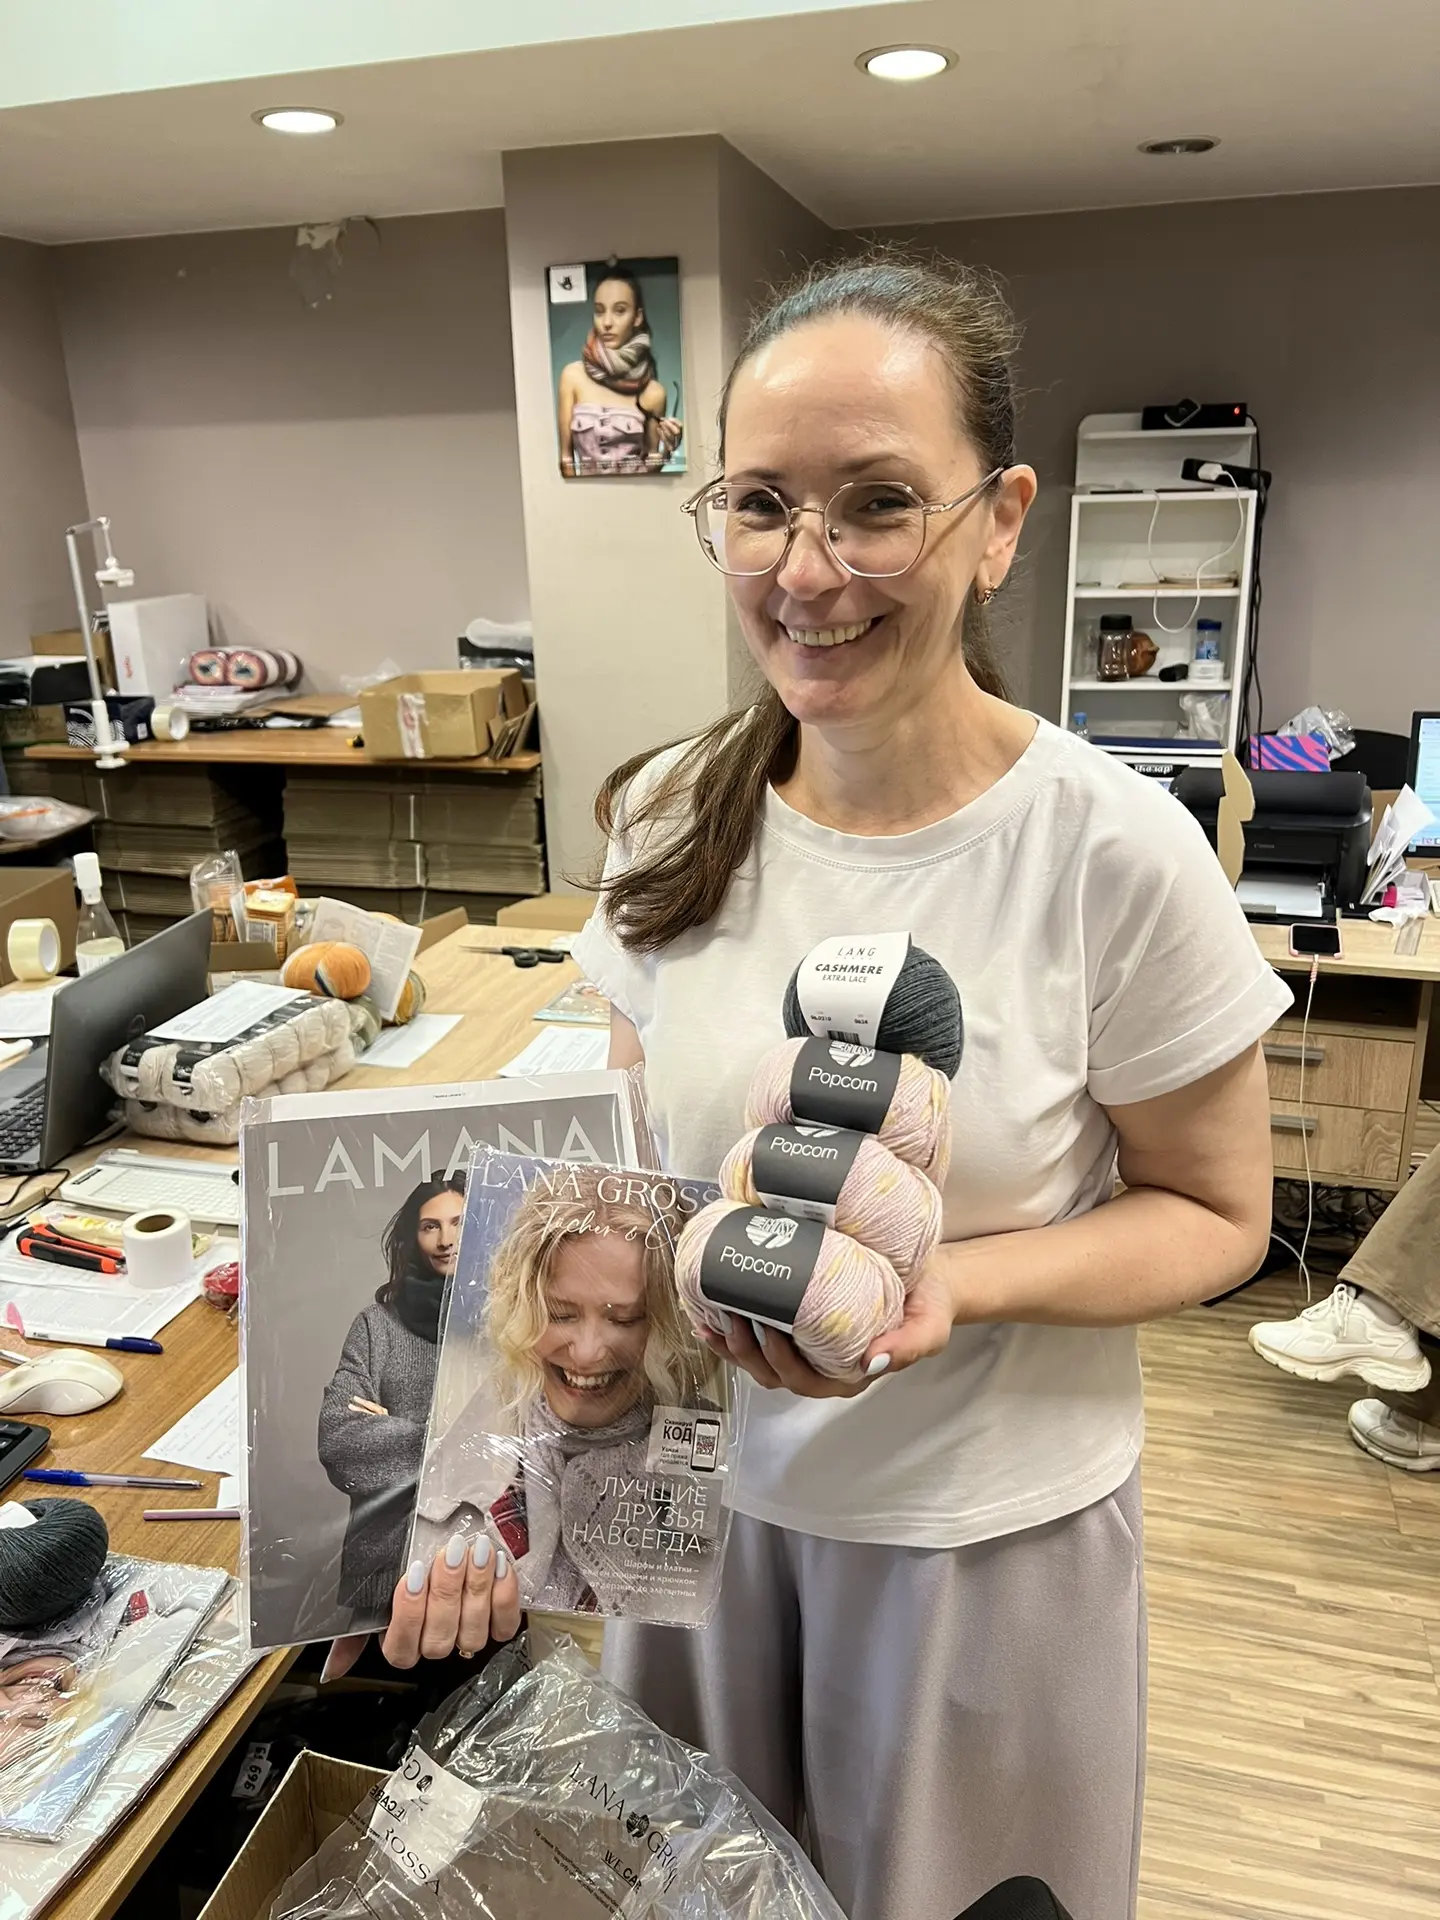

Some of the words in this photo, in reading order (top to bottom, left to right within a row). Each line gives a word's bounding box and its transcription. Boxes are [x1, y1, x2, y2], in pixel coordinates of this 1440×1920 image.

[838, 947, 876, 957] LANG
[815, 963, 884, 975] CASHMERE
[822, 974, 847, 982] EXTRA
[848, 975, 868, 984] LACE
[809, 1066, 878, 1093] Popcorn
[268, 1115, 603, 1197] LAMANA
[770, 1136, 839, 1160] Popcorn
[480, 1157, 582, 1199] LANA
[597, 1175, 723, 1214] GROSS
[645, 1213, 681, 1251] C
[719, 1245, 793, 1281] Popcorn
[663, 1425, 692, 1444] КОД
[599, 1476, 709, 1506] ЛУЧШИЕ
[611, 1502, 705, 1530] ДРУЗЬЯ
[572, 1521, 702, 1557] НАВСЕГДА
[569, 1761, 625, 1821] LANA
[604, 1850, 623, 1869] WE
